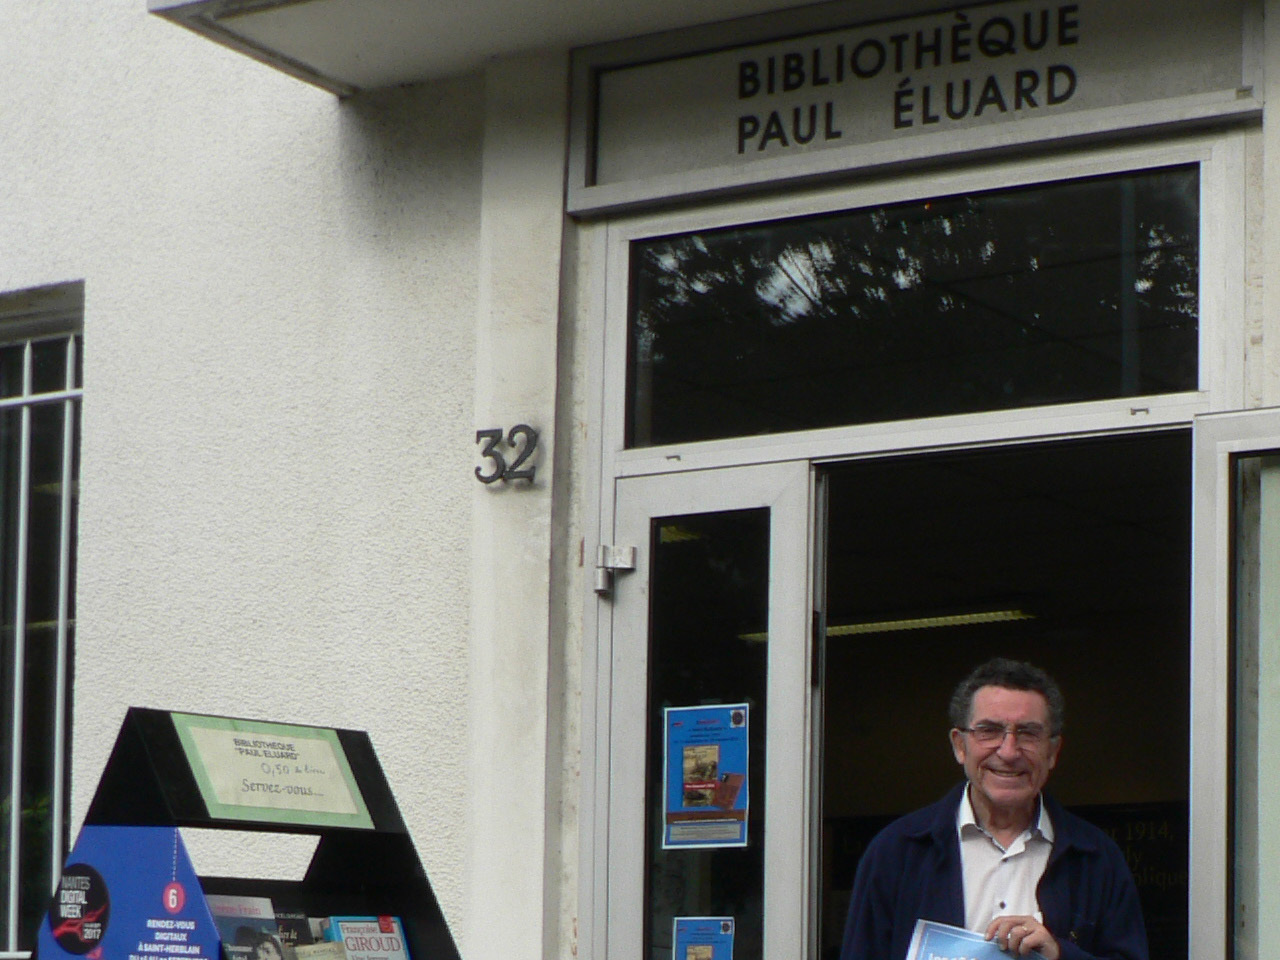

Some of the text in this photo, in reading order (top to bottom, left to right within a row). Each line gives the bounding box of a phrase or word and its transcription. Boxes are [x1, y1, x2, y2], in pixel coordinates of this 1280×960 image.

[737, 4, 1081, 100] BIBLIOTHÈQUE
[737, 64, 1078, 155] PAUL ÉLUARD
[475, 424, 537, 484] 32
[62, 876, 91, 890] NANTES
[60, 890, 88, 905] DIGITAL
[168, 889, 178, 909] 6
[60, 904, 82, 919] WEEK
[146, 919, 196, 930] RENDEZ-VOUS
[83, 929, 102, 940] 2017
[154, 932, 188, 941] DIGITAUX
[144, 943, 201, 955] SAINT-HERBLAIN
[345, 936, 402, 953] GIROUD
